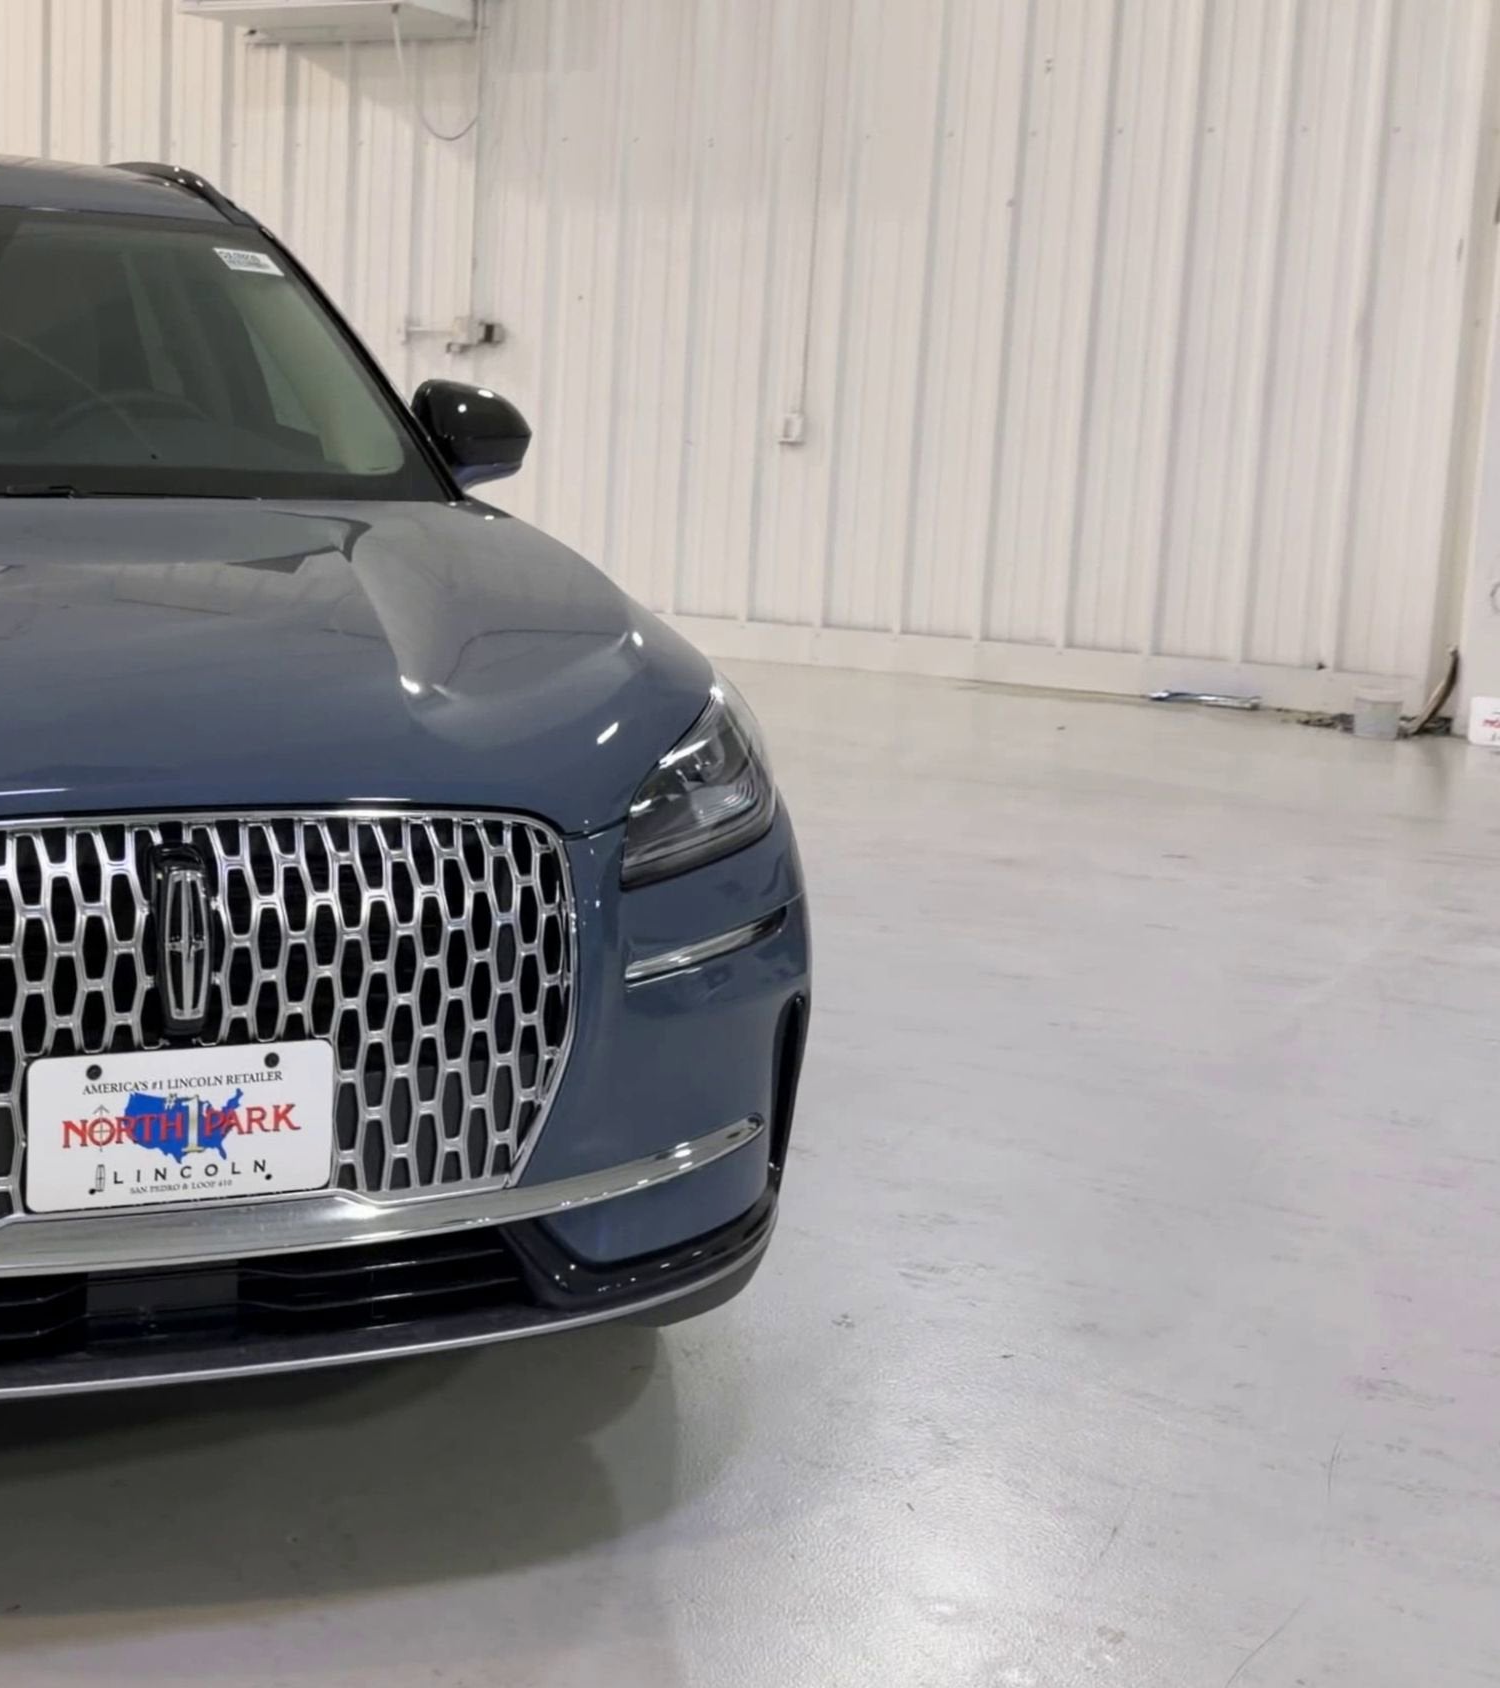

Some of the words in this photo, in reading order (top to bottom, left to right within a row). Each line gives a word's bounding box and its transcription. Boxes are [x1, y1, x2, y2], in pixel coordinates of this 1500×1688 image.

[82, 1081, 149, 1095] AMERICA'S
[151, 1080, 164, 1091] #1
[167, 1075, 223, 1090] LINCOLN
[226, 1070, 283, 1085] RETAILER
[62, 1111, 185, 1149] NORTH
[204, 1103, 301, 1136] PARK
[113, 1159, 267, 1185] LINCOLN
[130, 1186, 148, 1194] SAN
